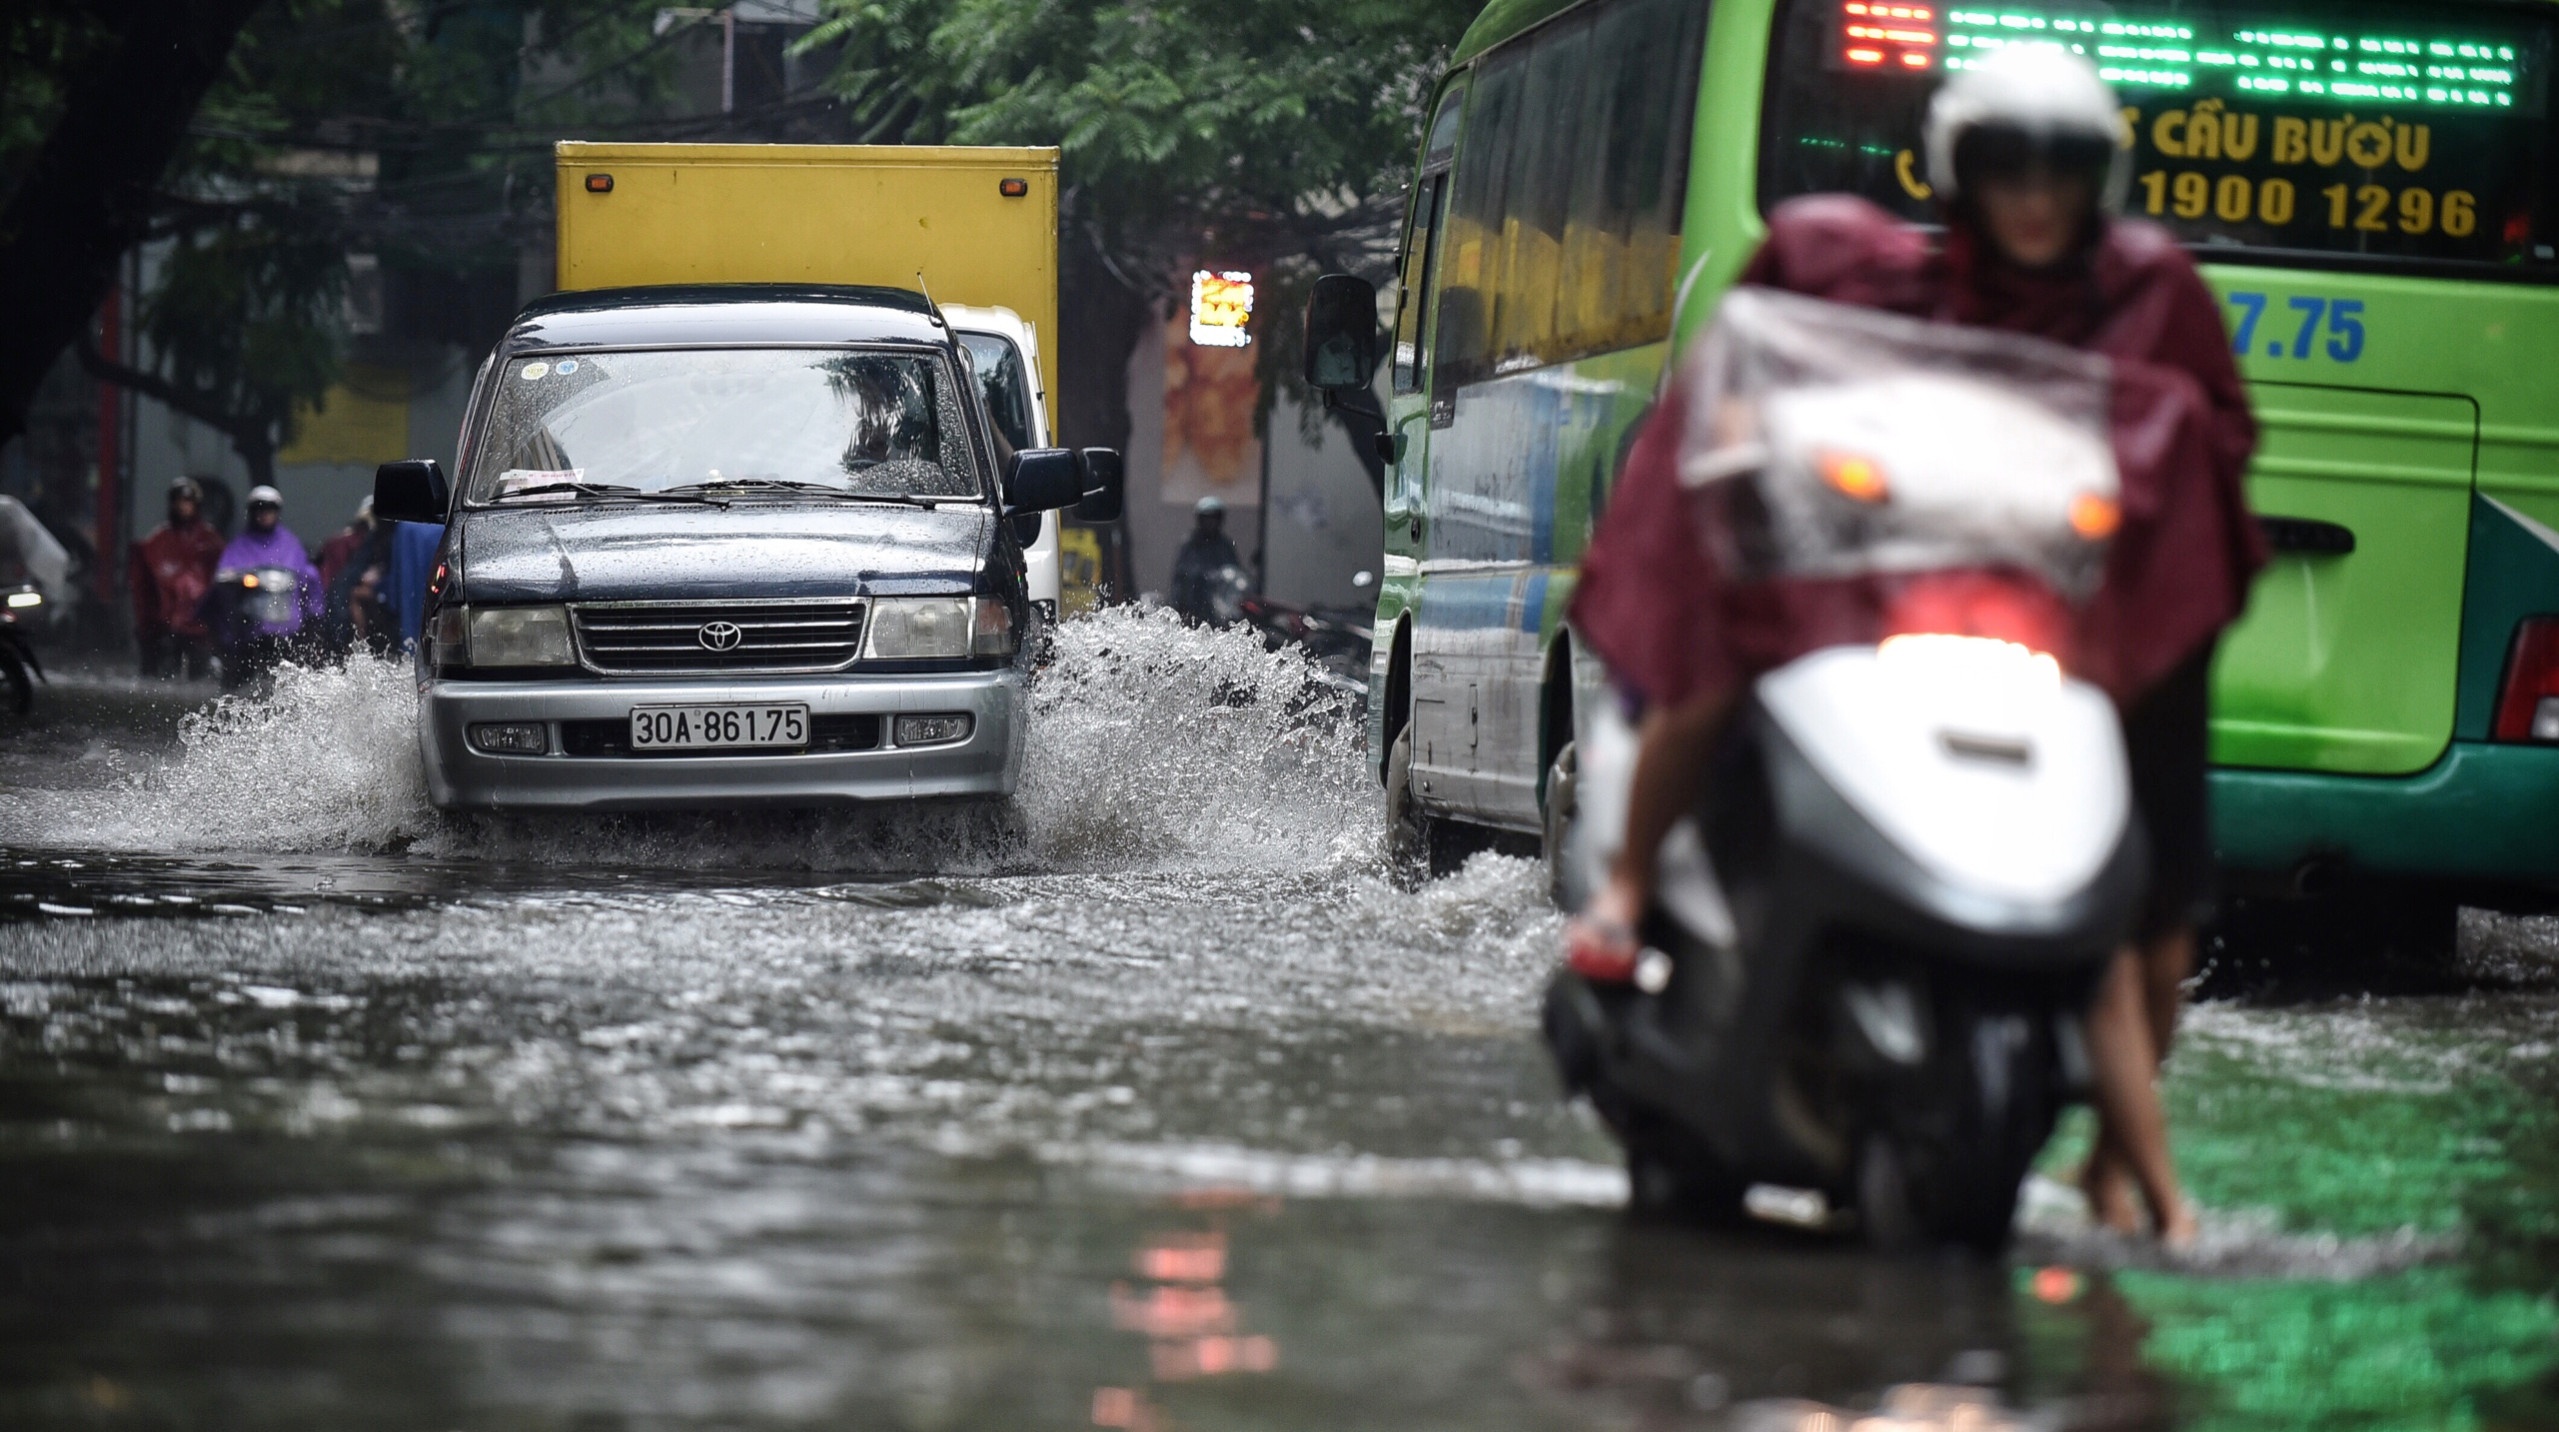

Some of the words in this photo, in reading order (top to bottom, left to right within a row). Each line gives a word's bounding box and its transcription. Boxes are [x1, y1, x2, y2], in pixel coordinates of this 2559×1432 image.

[2153, 98, 2259, 161] CẦU
[2140, 170, 2296, 225] 1900
[2322, 183, 2477, 236] 1296
[2214, 291, 2365, 363] 7.75
[636, 709, 803, 743] 30A-861.75
